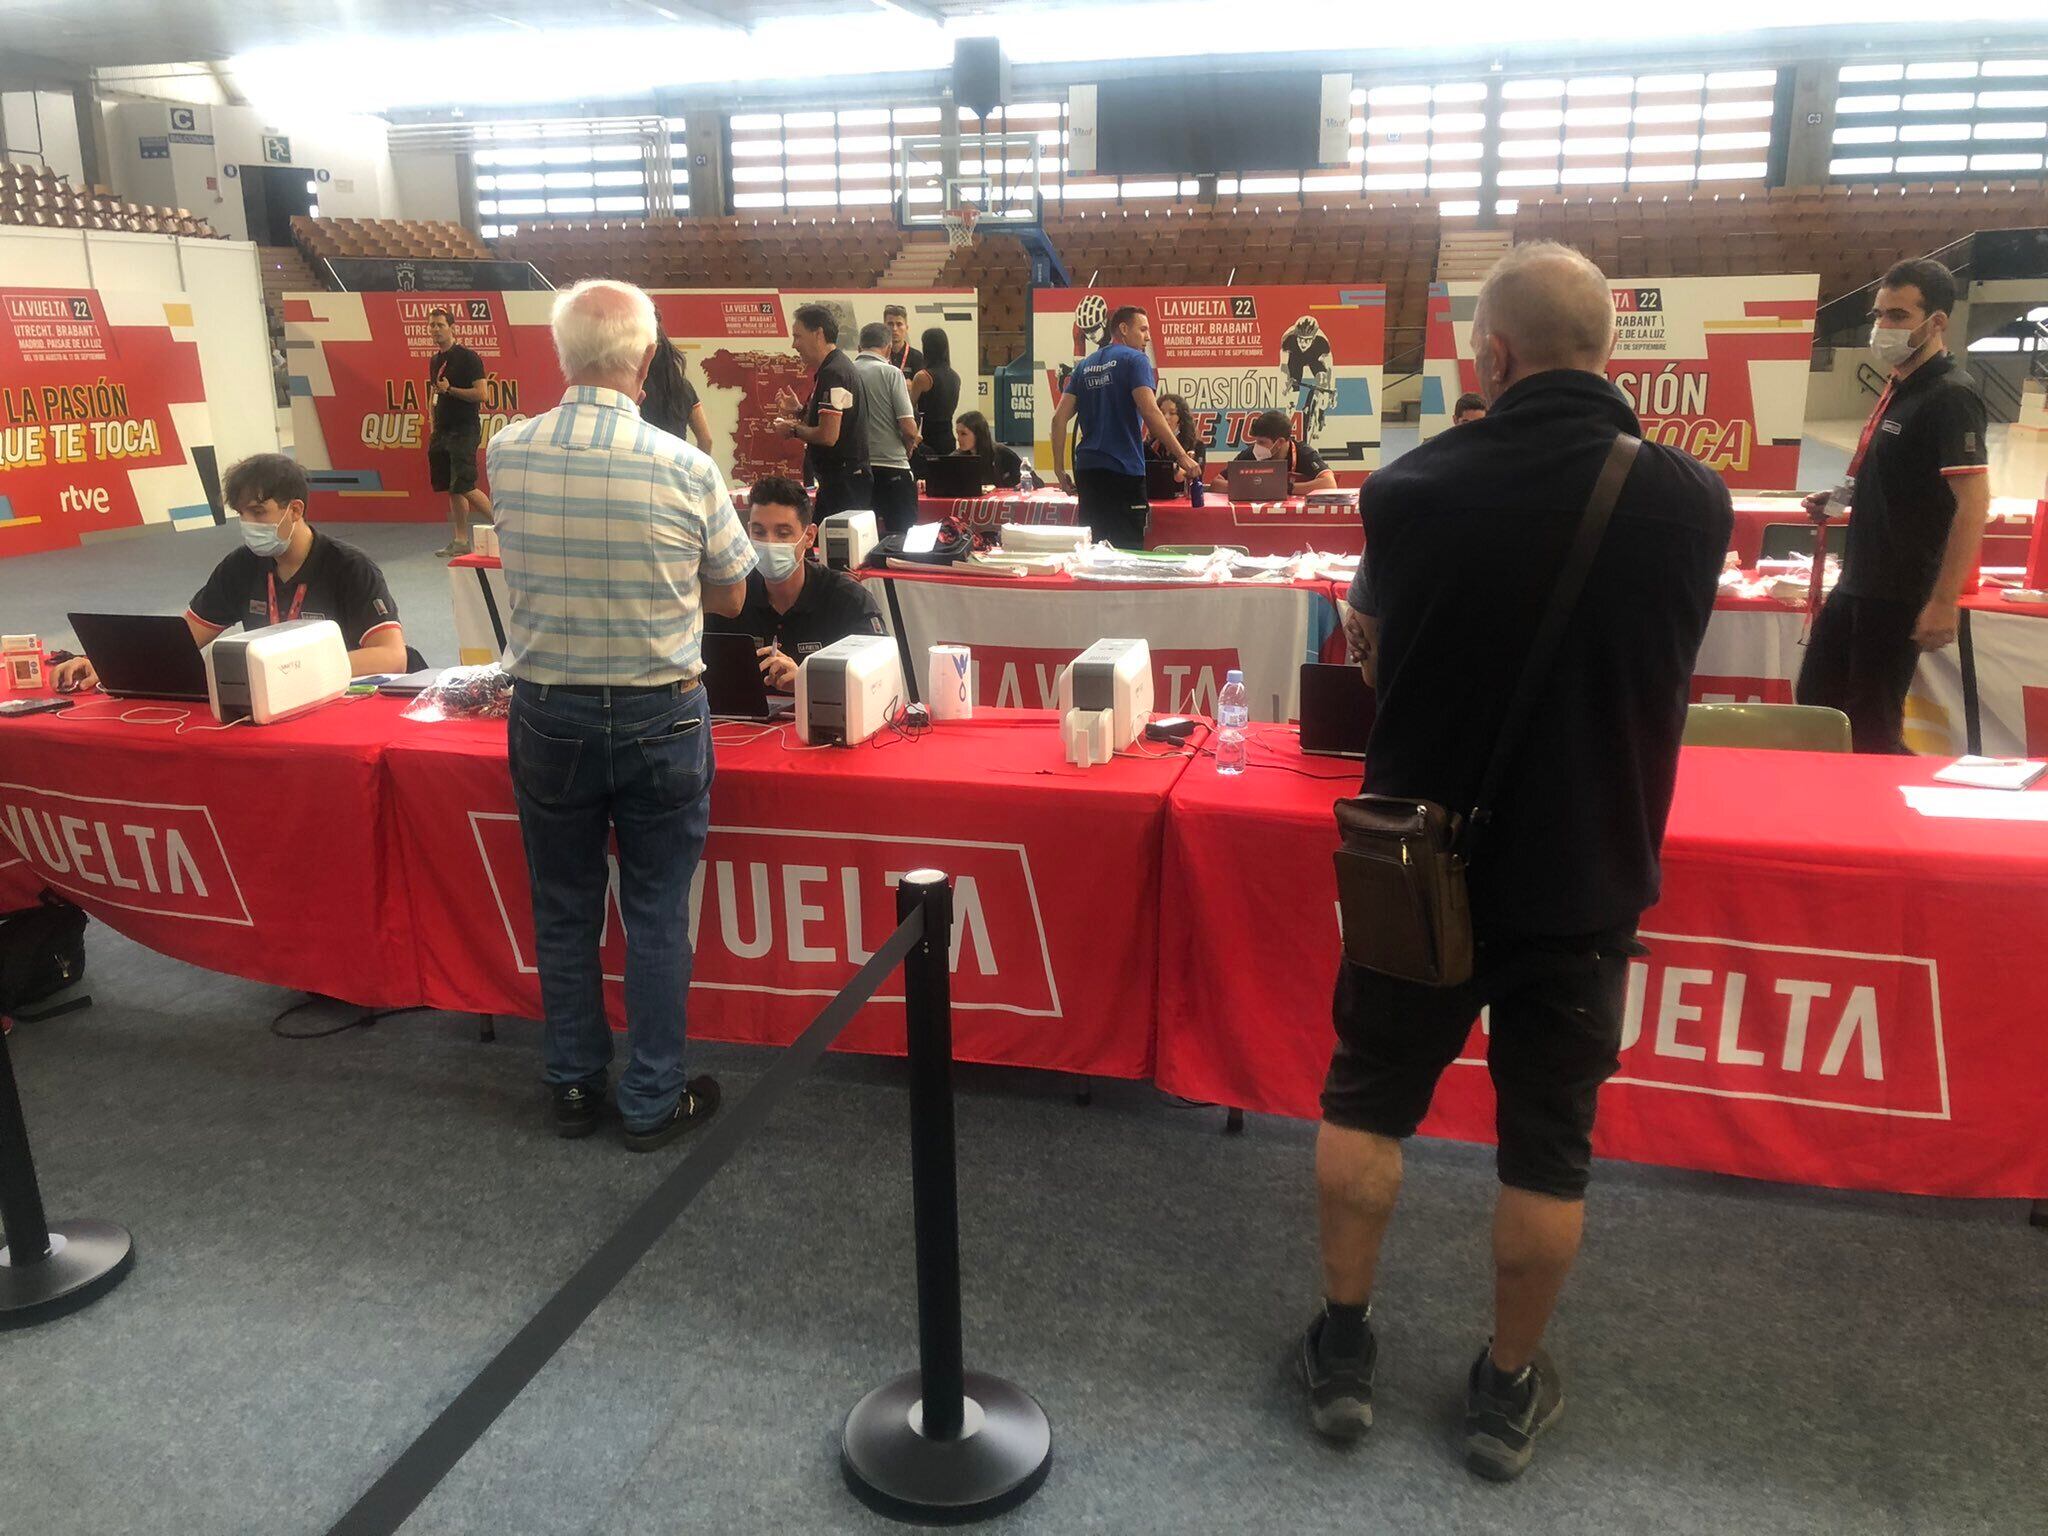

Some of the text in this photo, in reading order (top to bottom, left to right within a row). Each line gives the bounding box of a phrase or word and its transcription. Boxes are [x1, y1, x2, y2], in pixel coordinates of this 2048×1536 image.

[173, 110, 192, 129] C
[11, 300, 89, 317] LA VUELTA 22
[762, 304, 771, 313] 22
[1164, 300, 1251, 316] LA VUELTA 22
[1639, 292, 1658, 308] 22
[405, 303, 419, 318] LA
[471, 303, 487, 318] 22
[1209, 322, 1254, 334] BRABANT
[1615, 315, 1657, 327] RABANT
[55, 325, 93, 337] BRABANT
[1625, 329, 1636, 339] DE
[1637, 329, 1648, 339] LA
[1649, 329, 1665, 339] LUZ
[72, 338, 82, 349] DE
[81, 338, 91, 349] LA
[90, 338, 103, 349] LUZ
[464, 337, 474, 346] DE
[475, 337, 485, 346] LA
[485, 337, 498, 346] LUZ
[1195, 336, 1224, 346] PAISAJE
[1226, 336, 1235, 345] DE
[1236, 336, 1246, 345] LA
[1247, 335, 1261, 345] LUZ
[385, 378, 420, 411] LA
[1178, 369, 1278, 409] PASIÓN
[1603, 362, 1709, 416] SIÓN
[3, 376, 130, 424] LA PASIÓN
[360, 413, 423, 448] QUE
[1225, 410, 1305, 446] TOA
[0, 418, 159, 468] UE TE TOCA
[59, 484, 111, 514] rtve
[0, 804, 209, 897] VUELTA
[688, 859, 999, 975] UELA
[1620, 962, 1884, 1081] ELTA
